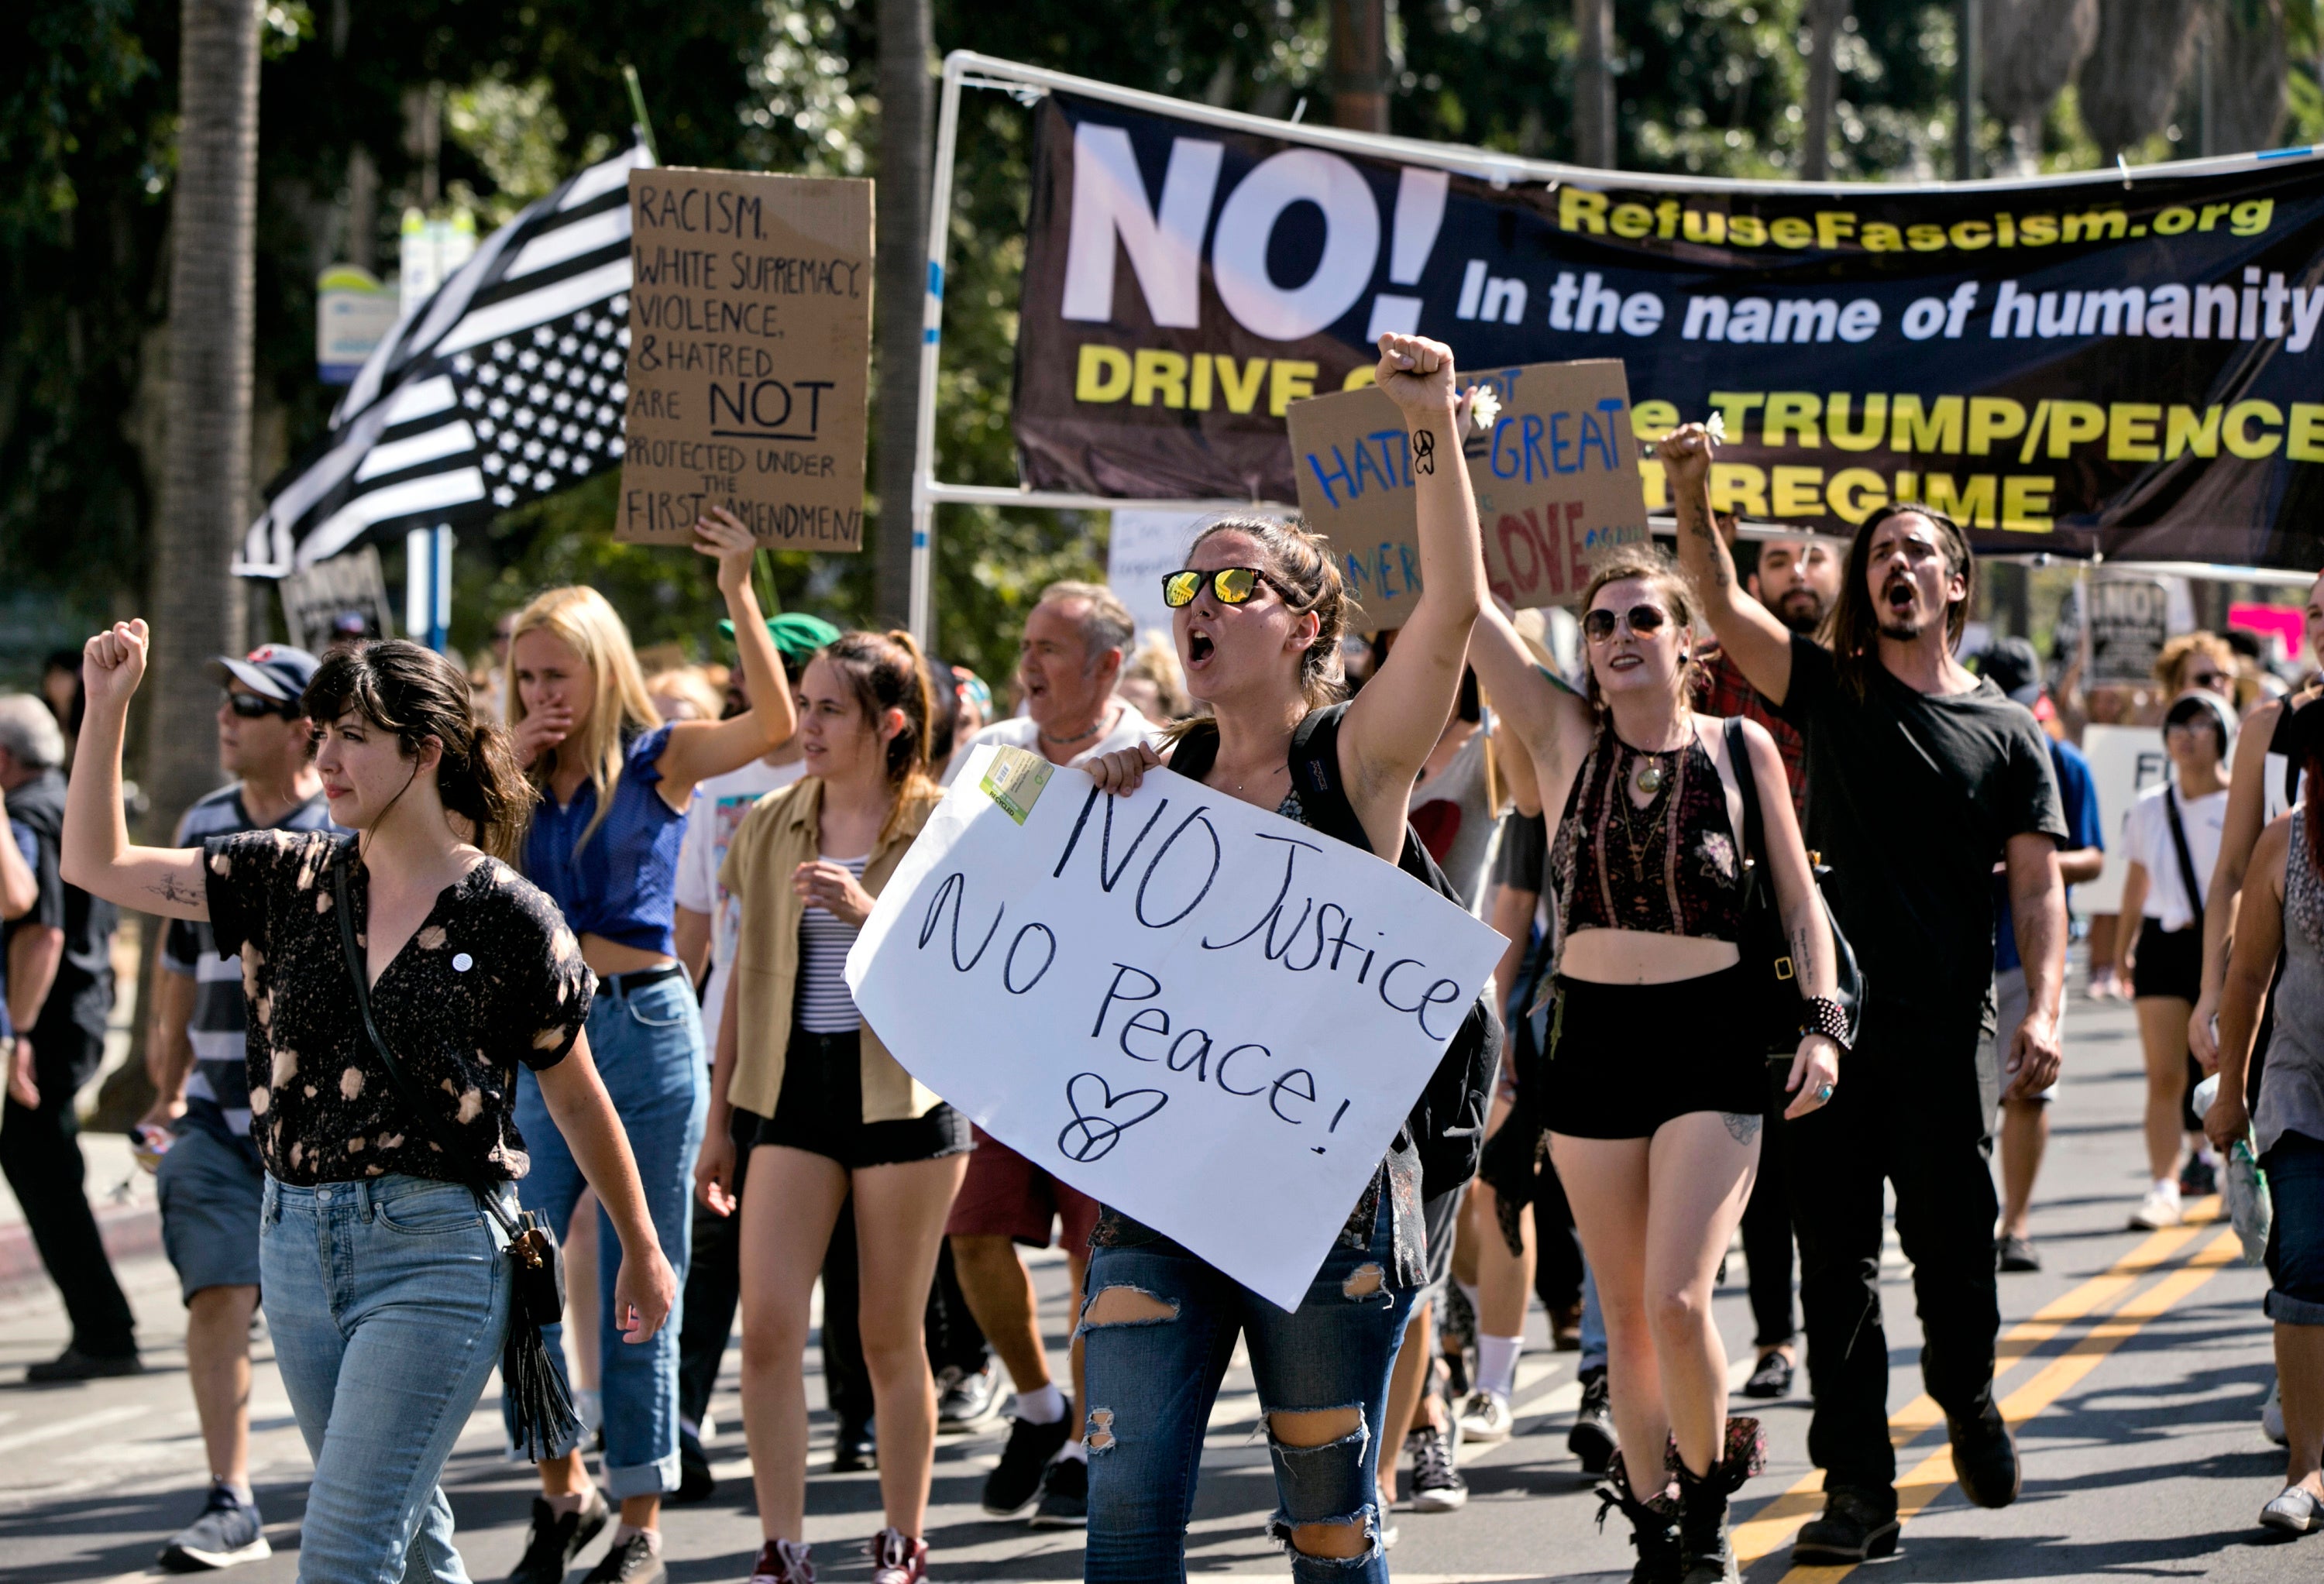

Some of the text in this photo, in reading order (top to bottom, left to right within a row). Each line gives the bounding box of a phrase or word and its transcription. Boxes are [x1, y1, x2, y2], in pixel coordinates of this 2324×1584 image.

[1062, 122, 1449, 345] NO!
[1558, 186, 2274, 253] RefuseFascism.org
[635, 245, 717, 290] WHITE
[1457, 260, 2324, 353] In the name of humanity
[631, 379, 835, 432] ARE NOT
[1075, 344, 1318, 417] DRIVE
[1708, 391, 2324, 464] TRUMP/PENCE
[625, 436, 835, 477] PROTECTED UNDER
[1491, 397, 1624, 484] GREAT
[627, 489, 706, 531] FIRST
[700, 473, 737, 493] THE
[988, 790, 1015, 817] RECYCLED
[1053, 783, 1221, 928] NO
